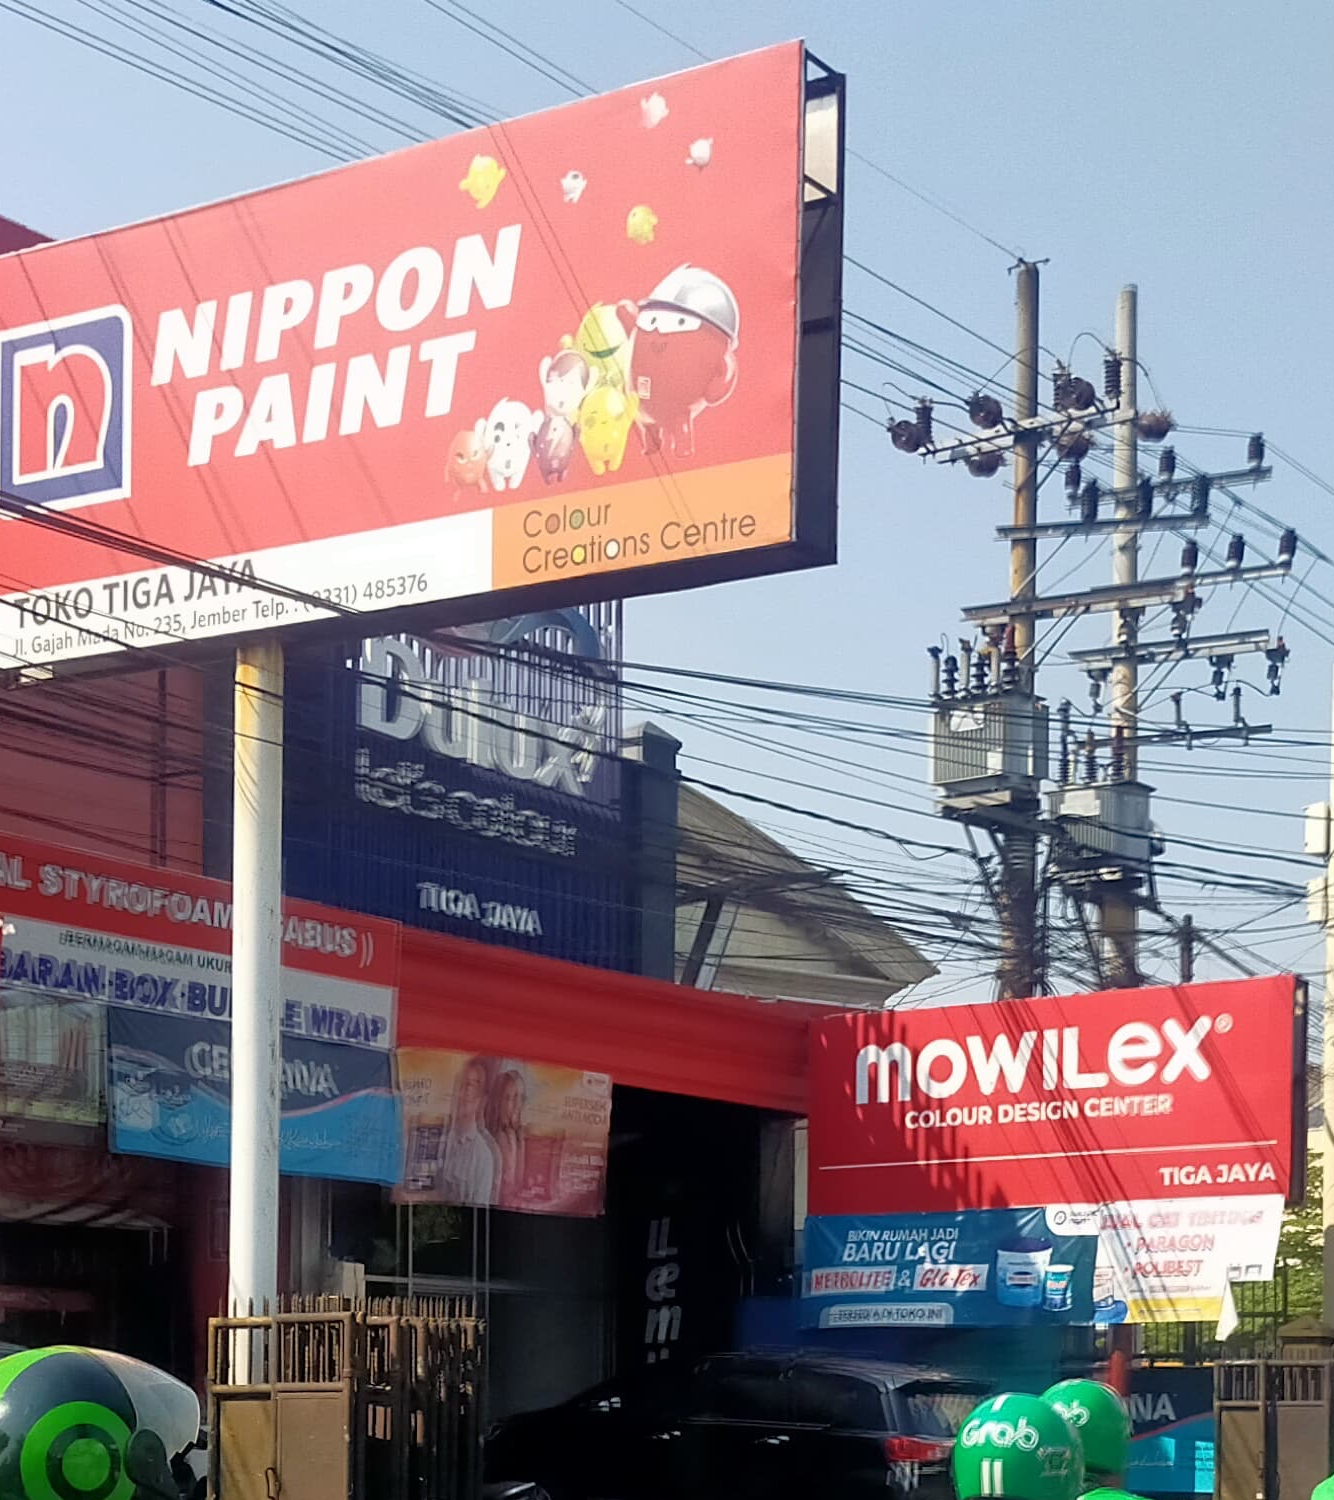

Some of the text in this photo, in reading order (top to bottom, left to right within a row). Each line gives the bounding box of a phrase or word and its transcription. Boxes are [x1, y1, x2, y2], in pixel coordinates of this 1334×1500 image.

[151, 224, 524, 387] NIPPON
[186, 330, 478, 468] PAINT
[522, 502, 612, 538] Colour
[522, 512, 757, 574] Creations Centre
[14, 557, 259, 629] TOKO TIGA JAYA
[31, 628, 75, 657] Gajah
[122, 618, 151, 641] No.
[152, 612, 188, 637] 235,
[190, 605, 248, 631] Jember
[362, 572, 429, 601] 485376
[354, 634, 606, 798] Dulux
[197, 954, 233, 975] UKUR
[903, 1093, 1173, 1131] COLOUR DESIGN CENTER
[1157, 1160, 1276, 1188] TIGA JAYA
[841, 1240, 958, 1263] BARU LAGI
[883, 1228, 929, 1243] RUMAH
[930, 1227, 960, 1241] JADI
[961, 1415, 1040, 1451] Grab
